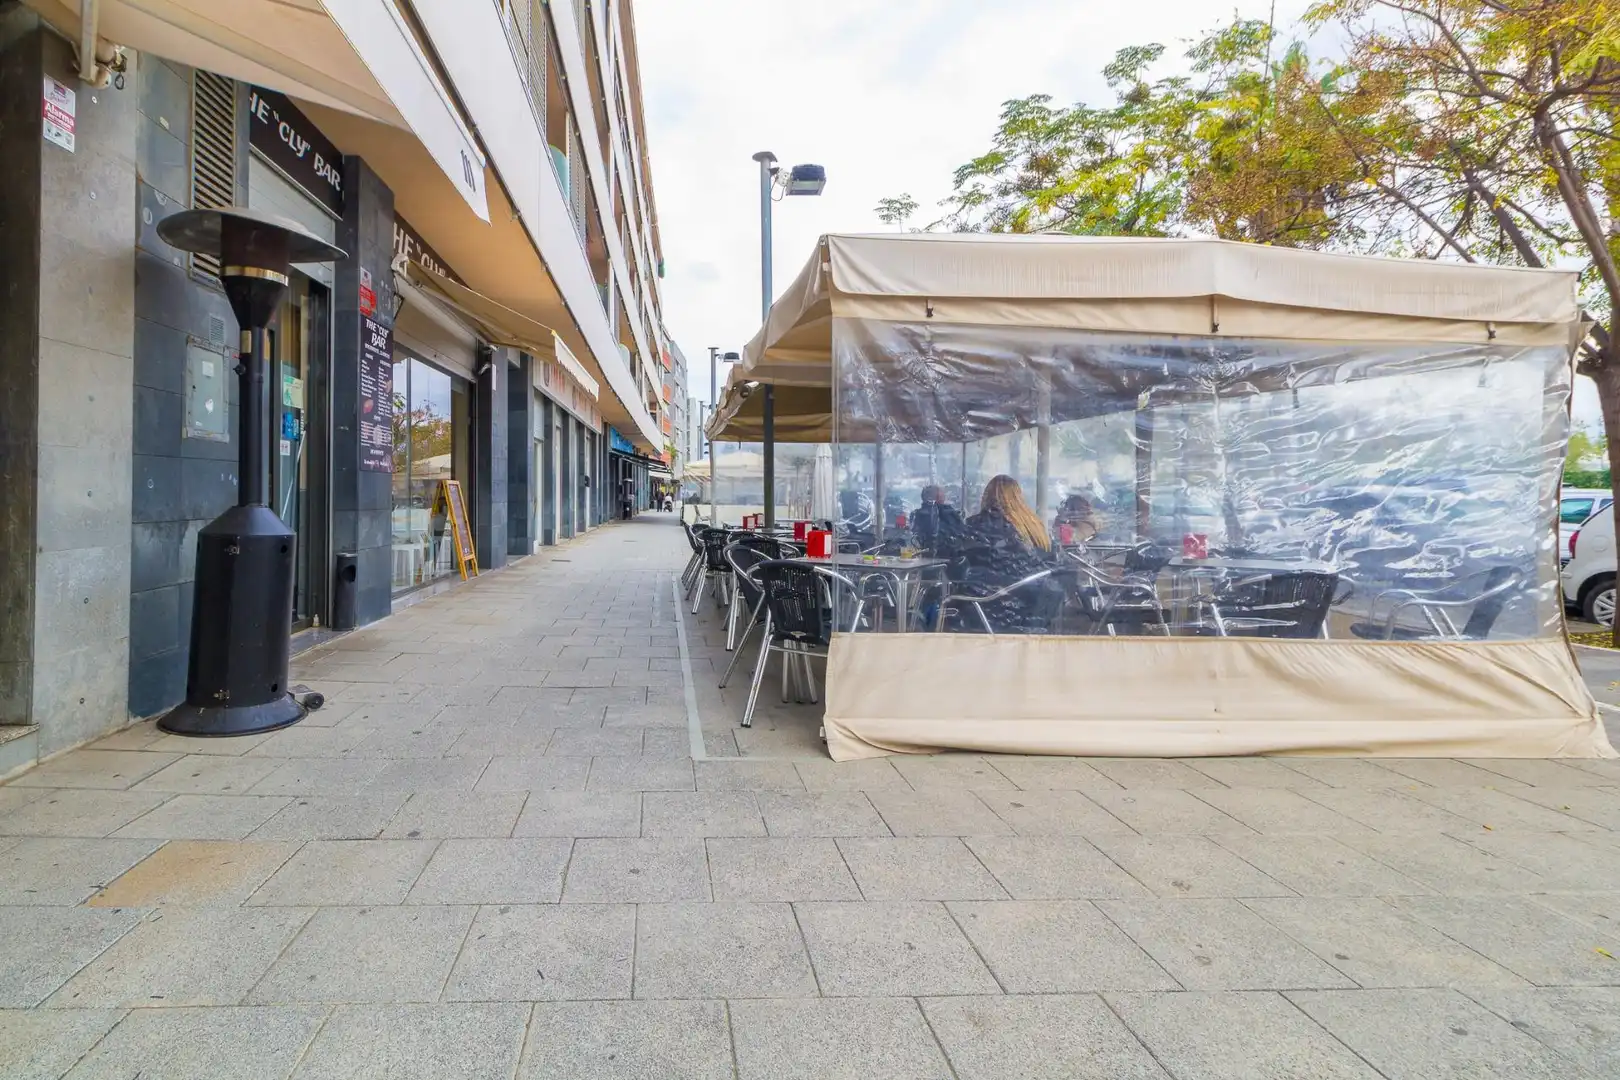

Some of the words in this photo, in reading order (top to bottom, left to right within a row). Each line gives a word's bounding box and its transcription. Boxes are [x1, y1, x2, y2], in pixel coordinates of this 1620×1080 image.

[314, 152, 341, 191] BAR
[366, 318, 377, 332] THE
[371, 332, 386, 350] BAR
